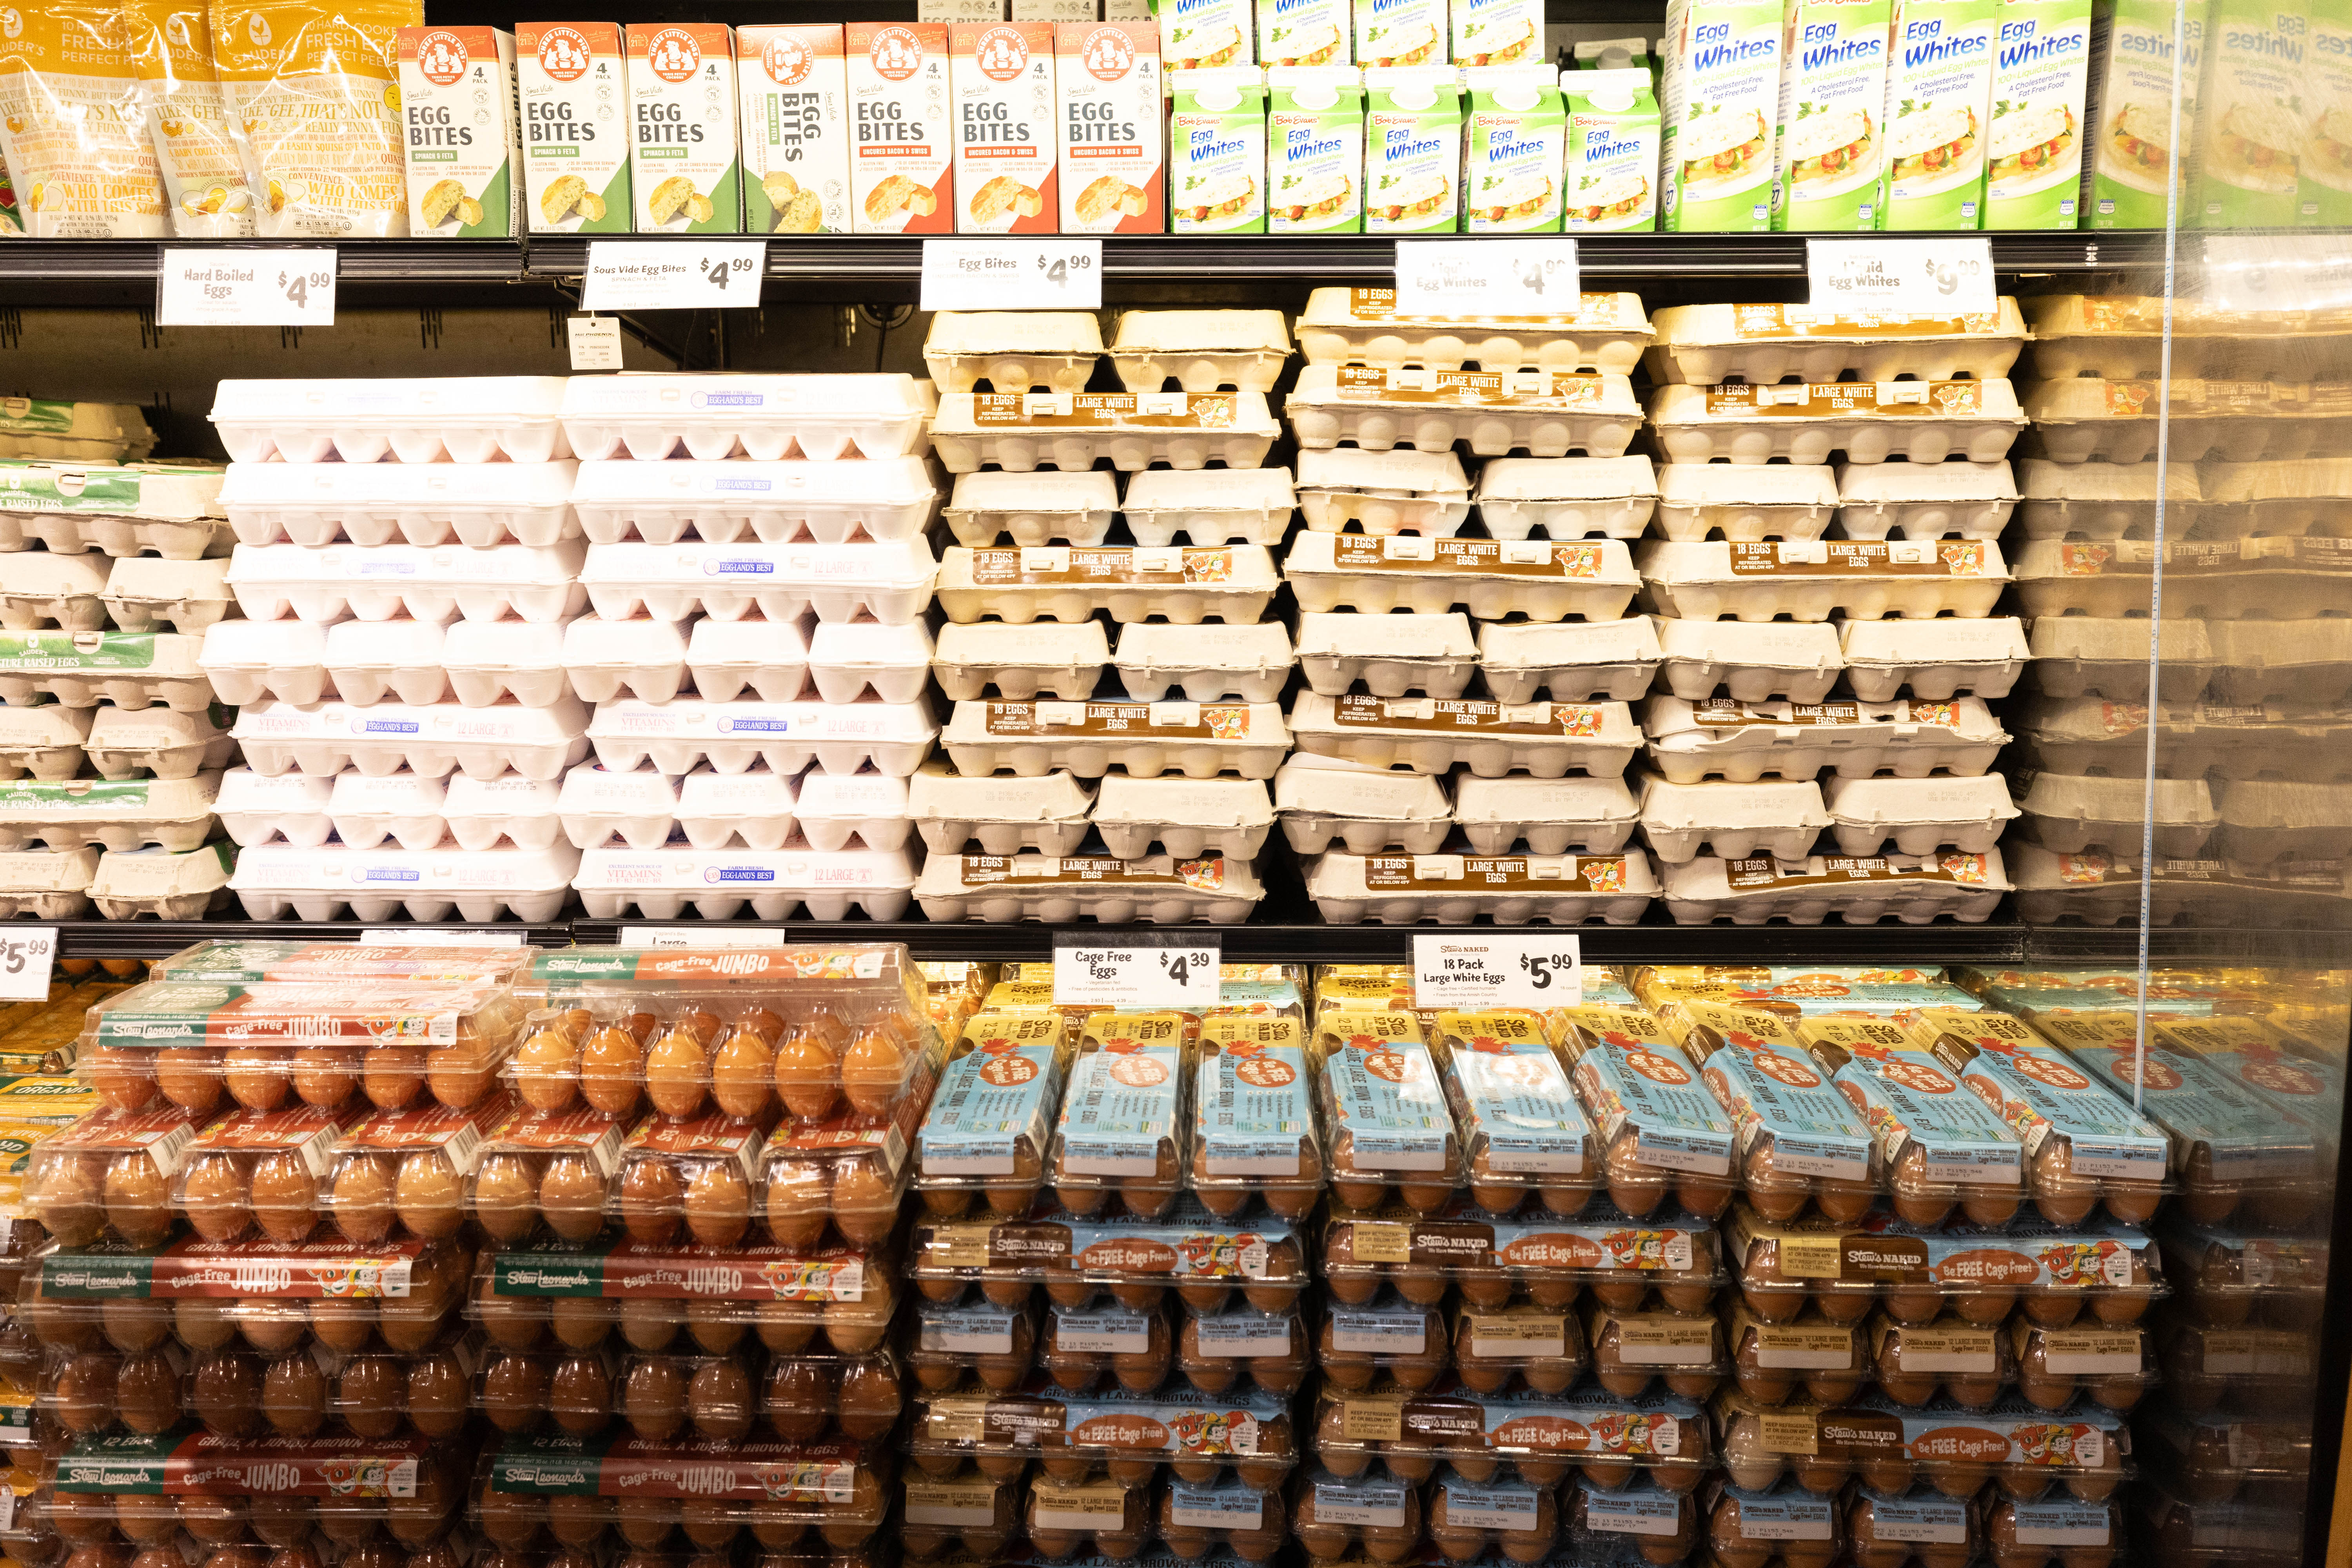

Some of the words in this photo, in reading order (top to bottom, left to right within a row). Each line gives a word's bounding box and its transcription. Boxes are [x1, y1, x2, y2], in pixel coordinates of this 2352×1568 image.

[1695, 23, 1729, 45] Egg
[2001, 20, 2036, 42] Egg
[306, 33, 356, 48] FRESH
[540, 33, 554, 55] THREE
[555, 29, 578, 40] LITTLE
[577, 38, 588, 56] PIGS
[1695, 40, 1775, 72] Whites
[2000, 34, 2082, 70] Whites
[597, 63, 607, 73] 4
[2017, 65, 2042, 79] Liquid
[2043, 62, 2058, 73] Egg
[2060, 56, 2085, 67] Whites
[2015, 73, 2054, 90] Cholesterol
[2048, 80, 2065, 90] Food
[526, 87, 539, 96] Sous
[528, 102, 572, 120] EGG
[802, 93, 821, 139] EGG
[782, 93, 802, 162] BITES
[1176, 117, 1195, 126] Bob
[1196, 117, 1220, 125] Evans
[529, 123, 595, 141] BITES
[1191, 130, 1213, 144] Egg
[287, 142, 312, 151] EASILY
[316, 143, 343, 151] SQUISH
[1191, 140, 1244, 163] Whites
[289, 173, 344, 184] CONVENIENCE.
[308, 181, 344, 196] WHO
[350, 185, 397, 200] COMES
[308, 194, 341, 207] WITH
[347, 200, 375, 209] THIS
[619, 265, 639, 273] Vide
[642, 265, 659, 275] Egg
[959, 258, 981, 271] Egg
[985, 258, 1017, 269] Bites
[184, 268, 211, 281] Hard
[215, 269, 253, 281] Boiled
[1829, 276, 1852, 290] Egg
[1856, 275, 1900, 287] Whites
[204, 284, 232, 299] Eggs
[1076, 397, 1102, 408] LARGE
[1105, 397, 1134, 408] WHITE
[1094, 408, 1116, 419] EGGS
[24, 658, 56, 667] RAISED
[58, 658, 80, 666] EGGS
[1373, 858, 1381, 869] 18
[1385, 859, 1407, 869] EGGS
[1467, 862, 1494, 872] LARGE
[1496, 862, 1524, 872] WHITE
[607, 869, 662, 878] VITAMINS
[815, 869, 823, 880] 12
[826, 869, 854, 880] LARGE
[1486, 873, 1506, 883] EGGS
[547, 958, 573, 972] Stew
[575, 960, 624, 973] Leonard's
[655, 956, 712, 972] Cage-Free
[711, 954, 769, 974] JUMBO
[1075, 951, 1103, 965] Cage
[1107, 951, 1132, 962] Free
[1444, 959, 1455, 969] 18
[1458, 959, 1484, 969] Pack
[1090, 965, 1116, 979] Eggs
[1425, 974, 1450, 985] Large
[1454, 973, 1480, 982] White
[1484, 974, 1505, 984] Eggs
[113, 1024, 140, 1037] Stew
[143, 1025, 192, 1039] Leonard's
[225, 1020, 283, 1038] Cage-Free
[283, 1016, 341, 1041] JUMBO
[1848, 1250, 1881, 1263] Stew's
[1882, 1254, 1921, 1264] NAKED
[1944, 1265, 1956, 1276] Be
[1956, 1261, 1982, 1277] FREE
[1985, 1262, 2009, 1279] Cage
[2010, 1259, 2032, 1274] Free!
[1512, 1428, 1537, 1443] FREE
[1539, 1429, 1562, 1446] Cage
[619, 1468, 677, 1487] Cage-Free
[677, 1466, 736, 1494] JUMBO
